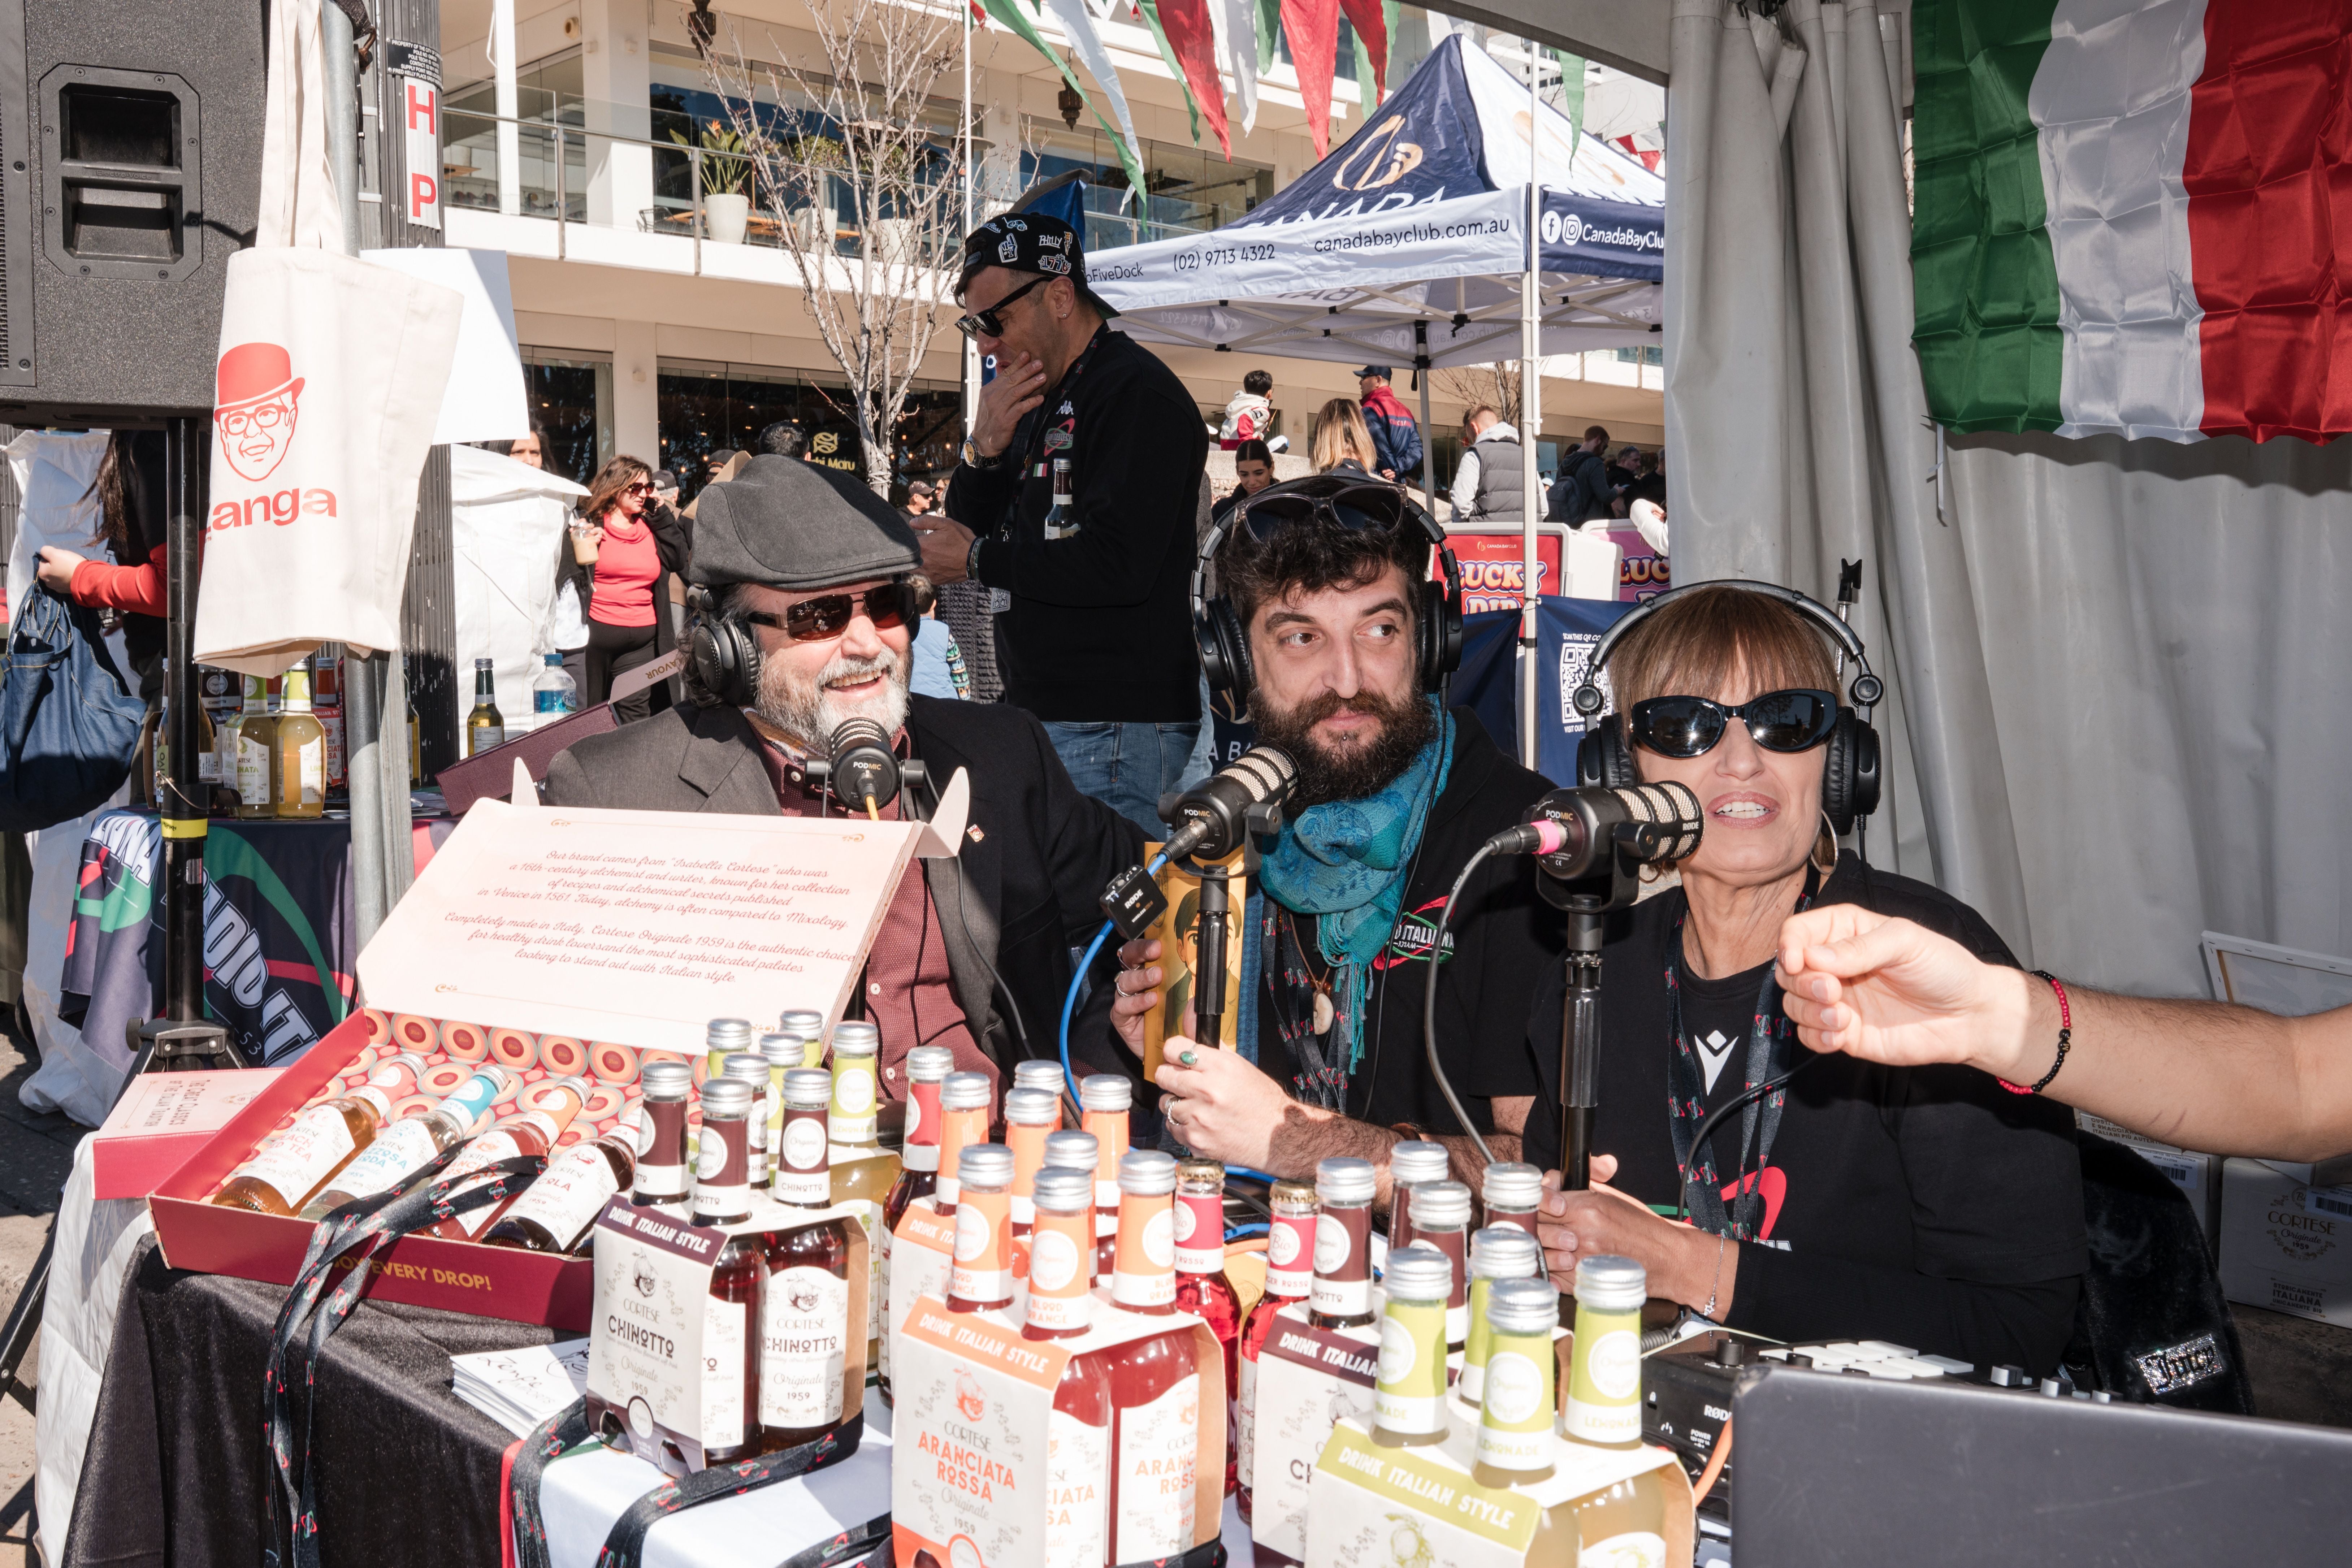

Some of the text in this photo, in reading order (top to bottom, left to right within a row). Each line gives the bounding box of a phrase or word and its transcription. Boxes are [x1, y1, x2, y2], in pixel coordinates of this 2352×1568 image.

[392, 40, 413, 48] PROPERTY
[408, 85, 435, 135] H
[412, 173, 437, 217] P
[1039, 235, 1062, 249] PHILLY
[1174, 253, 1201, 273] (02)
[1205, 248, 1236, 268] 9713
[1240, 244, 1275, 263] 4322
[1313, 217, 1510, 253] canadabayclub.com.au
[1041, 256, 1070, 274] 1776
[828, 457, 856, 471] Maru
[853, 761, 882, 770] PODMIC
[1184, 809, 1210, 817] PODMIC
[1546, 810, 1573, 821] PODMIC
[1682, 822, 1699, 831] RØDE
[546, 850, 567, 860] Our
[568, 852, 603, 862] brand
[634, 856, 666, 867] from
[776, 865, 802, 877] who
[802, 870, 830, 878] was
[519, 863, 590, 877] 16th-century
[590, 867, 645, 879] alchemist
[645, 871, 668, 882] and
[671, 873, 706, 885] writer,
[709, 875, 748, 888] known
[746, 878, 769, 890] for
[769, 879, 791, 890] her
[792, 882, 852, 896] collection
[547, 878, 795, 907] of recipes and alchemical secrets published
[1124, 888, 1144, 909] RØDE
[494, 887, 530, 899] Venice
[530, 891, 542, 900] in
[574, 893, 611, 908] Today,
[614, 898, 663, 913] alchemy
[664, 901, 675, 911] is
[676, 901, 707, 915] often
[709, 908, 768, 920] compared
[768, 911, 781, 921] to
[787, 911, 849, 931] Mixology.
[445, 912, 856, 962] Completely made in Italy, Cortese Originale 1959 is the authentic choice
[1402, 925, 1454, 949] ITALINA
[467, 928, 805, 973] for healthy drink the most sophisticated palates
[515, 948, 736, 984] looking to stand out with Italian style.
[833, 1123, 874, 1134] LEMONADE
[2092, 1129, 2120, 1138] ITALIANI
[536, 1177, 571, 1192] COLA
[781, 1182, 823, 1192] CHINOTTO
[607, 1205, 711, 1254] DRINK ITALIAN STYLE
[909, 1218, 940, 1239] DRINK
[2267, 1210, 2336, 1236] CORTESE
[1272, 1234, 1291, 1250] Bio
[2280, 1228, 2322, 1244] Originale
[2292, 1241, 2309, 1250] 1959
[1179, 1256, 1205, 1265] ROSSO
[371, 1258, 493, 1291] EVERY DROP!
[1282, 1279, 1309, 1288] ROSSO
[2272, 1289, 2322, 1308] ITALIANA
[2273, 1282, 2323, 1299] STORICAMENTE
[623, 1298, 660, 1324] CORTESE
[1032, 1300, 1063, 1313] BLOOD
[2272, 1298, 2310, 1311] UNICAMENTE
[777, 1318, 826, 1330] CORTESE
[608, 1315, 674, 1359] CHINOTTO
[919, 1313, 1050, 1373] DRINK ITALIAN STYLE
[1278, 1331, 1322, 1359] DRINK
[621, 1355, 659, 1383] Originale
[631, 1380, 648, 1395] 1959
[773, 1372, 824, 1389] Originale
[787, 1392, 810, 1401] 1959
[944, 1420, 992, 1453] CORTESE
[1690, 1429, 1711, 1441] POWER
[917, 1430, 1016, 1491] ARANCIATA
[937, 1459, 993, 1503] ROSSA
[1338, 1446, 1387, 1478] DRINK
[1387, 1465, 1456, 1507] ITALIAN
[1457, 1494, 1515, 1530] STYLE
[941, 1486, 990, 1521] Originale
[954, 1516, 976, 1535] 1959
